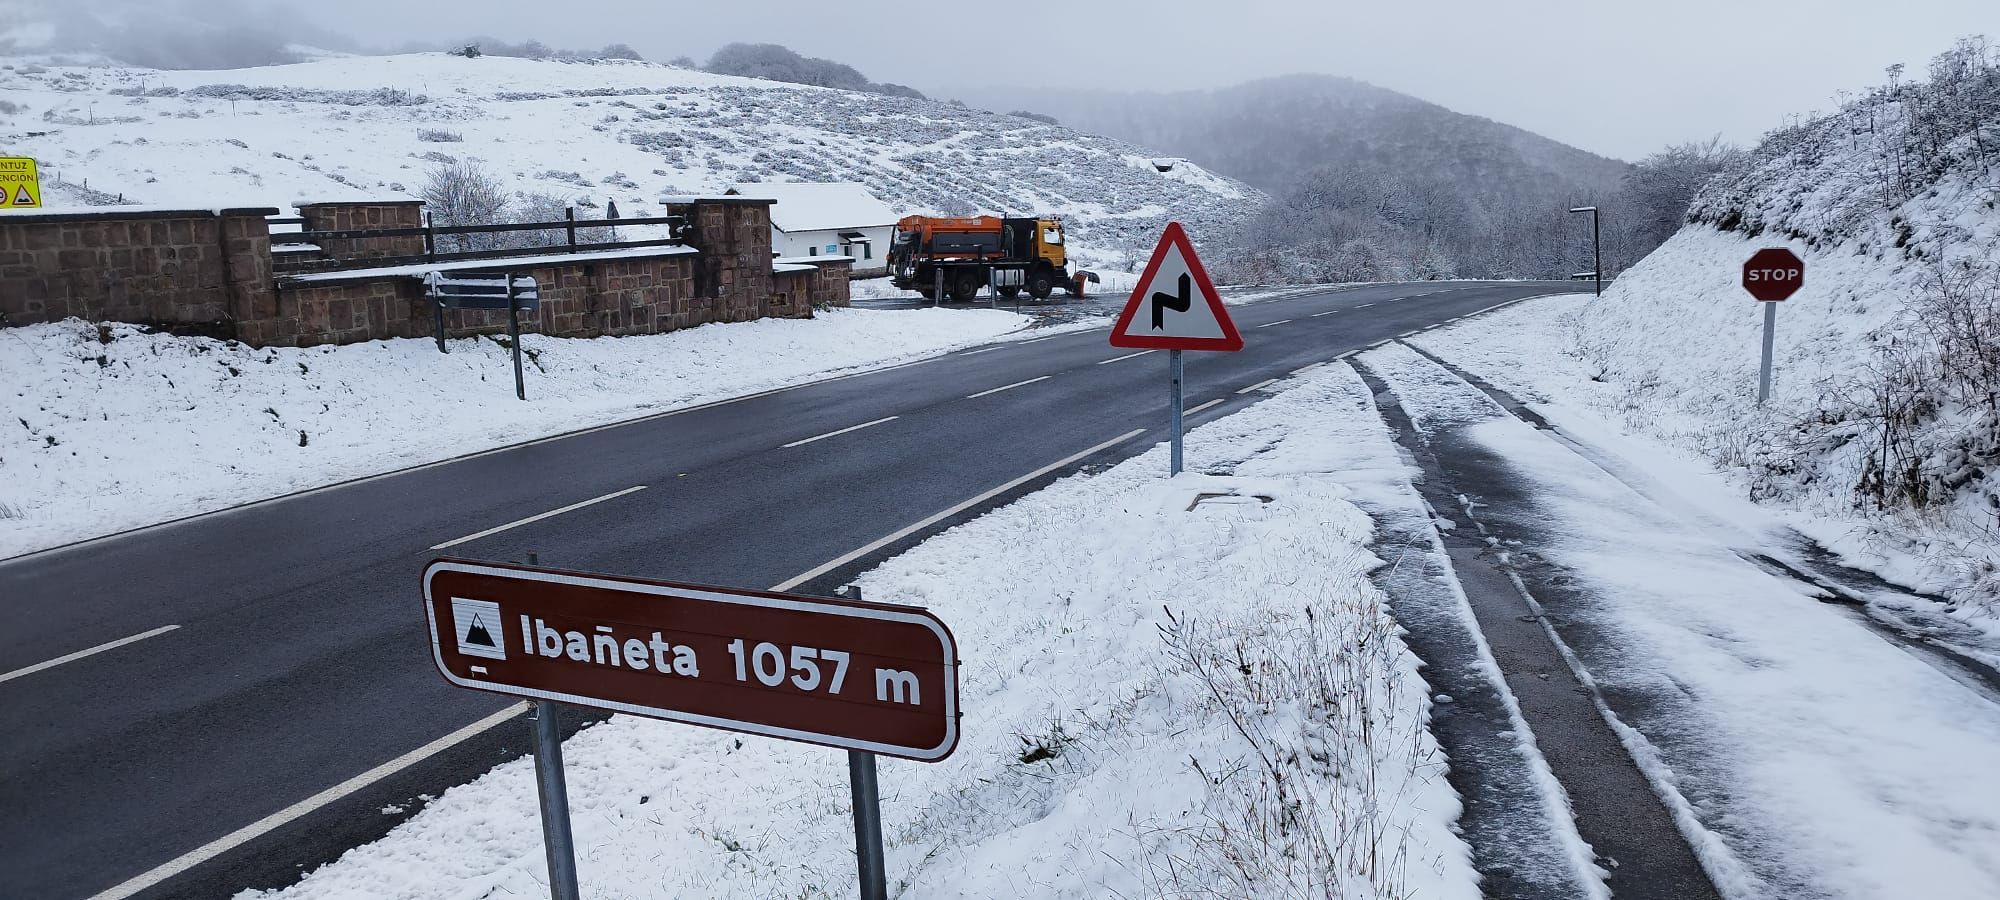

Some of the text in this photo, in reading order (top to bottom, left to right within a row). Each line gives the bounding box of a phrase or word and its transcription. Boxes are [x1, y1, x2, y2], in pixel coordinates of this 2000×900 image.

[1748, 268, 1799, 281] STOP
[519, 614, 921, 706] Ibañeta 1057 m
